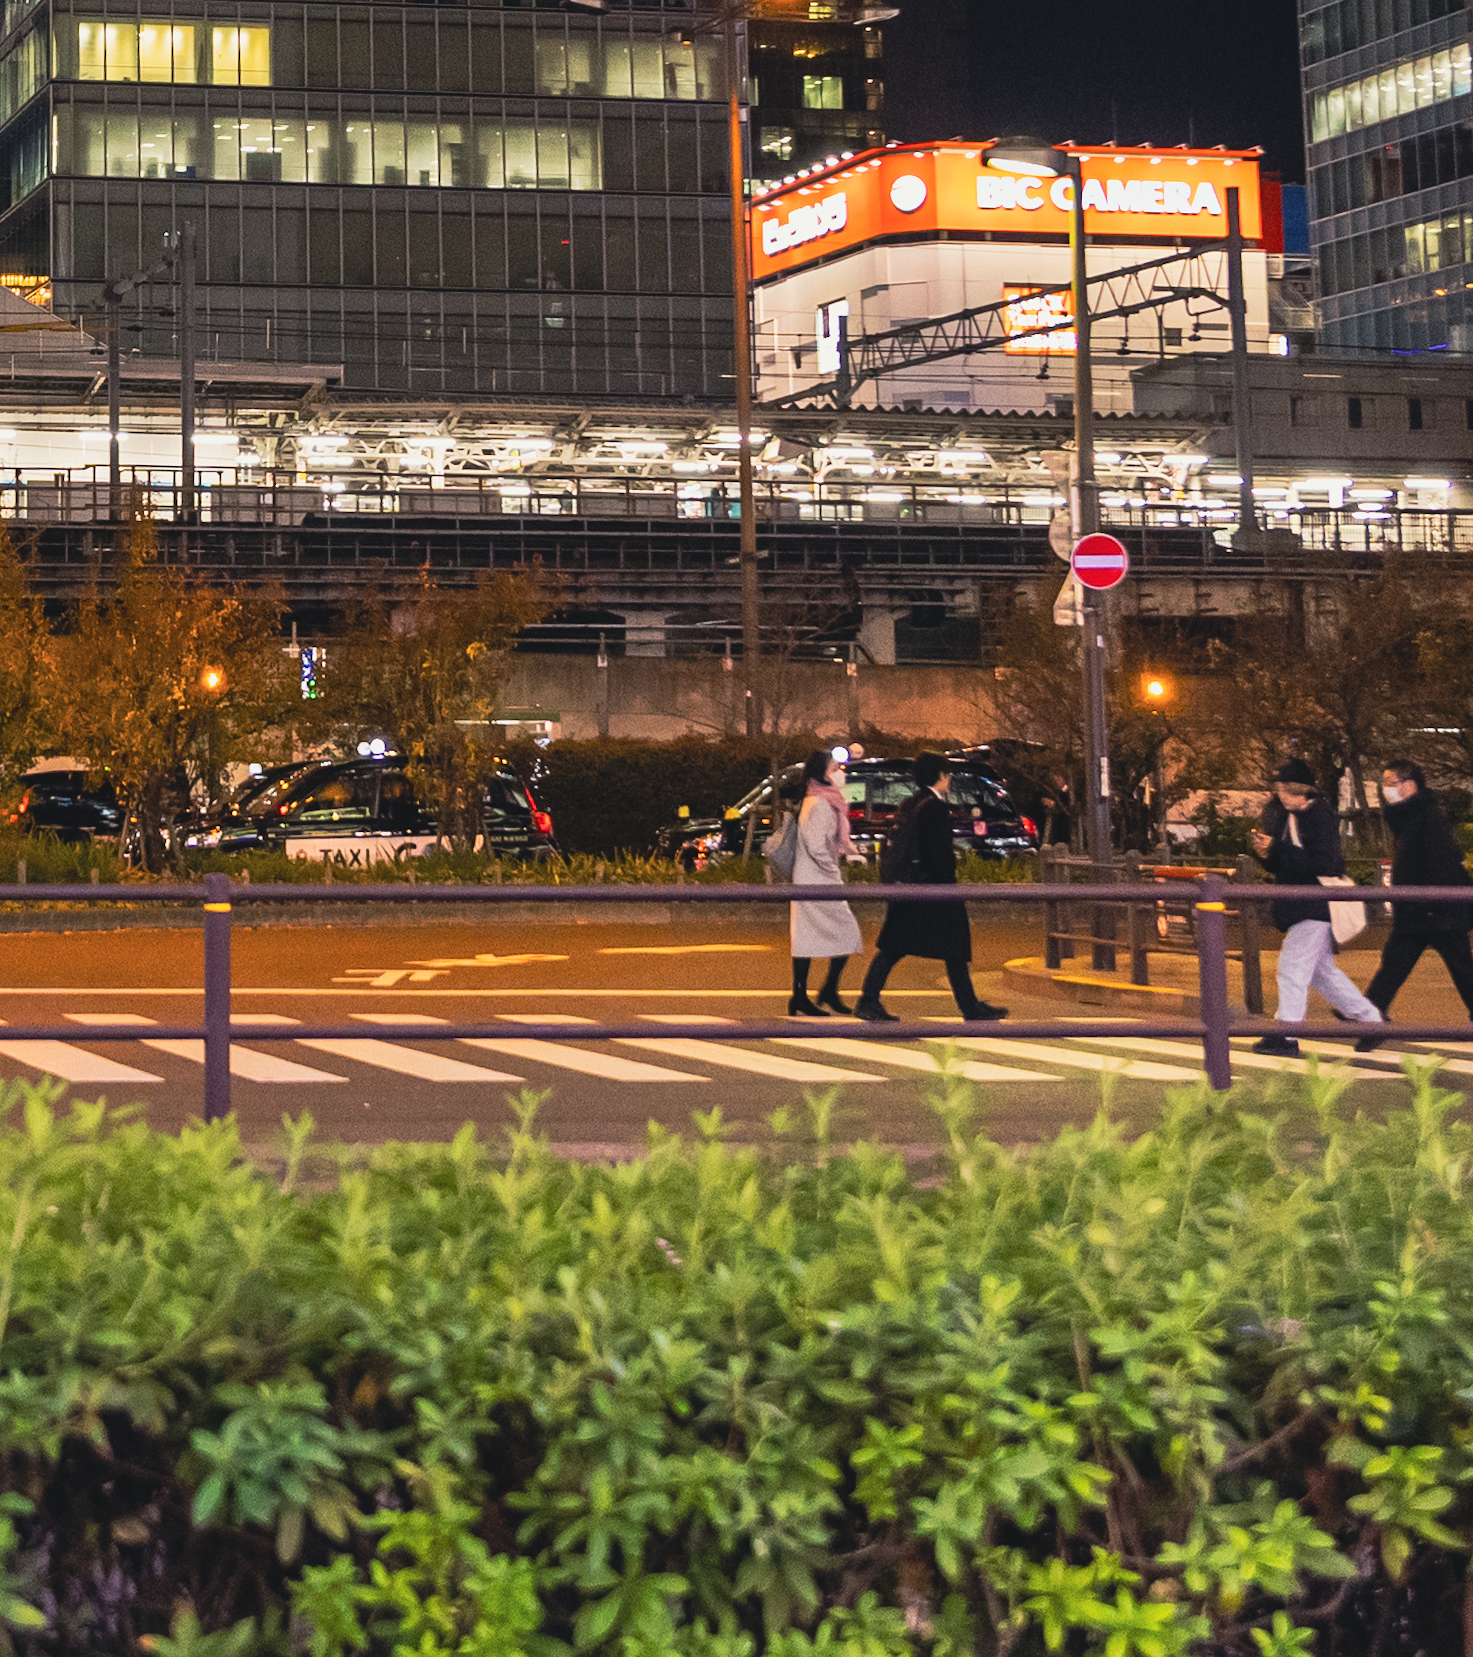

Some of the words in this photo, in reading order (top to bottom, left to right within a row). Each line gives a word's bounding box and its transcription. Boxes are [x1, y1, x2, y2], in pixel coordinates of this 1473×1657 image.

[976, 175, 1045, 210] BIC
[1050, 177, 1223, 215] CAMERA
[319, 849, 371, 869] TAXI
